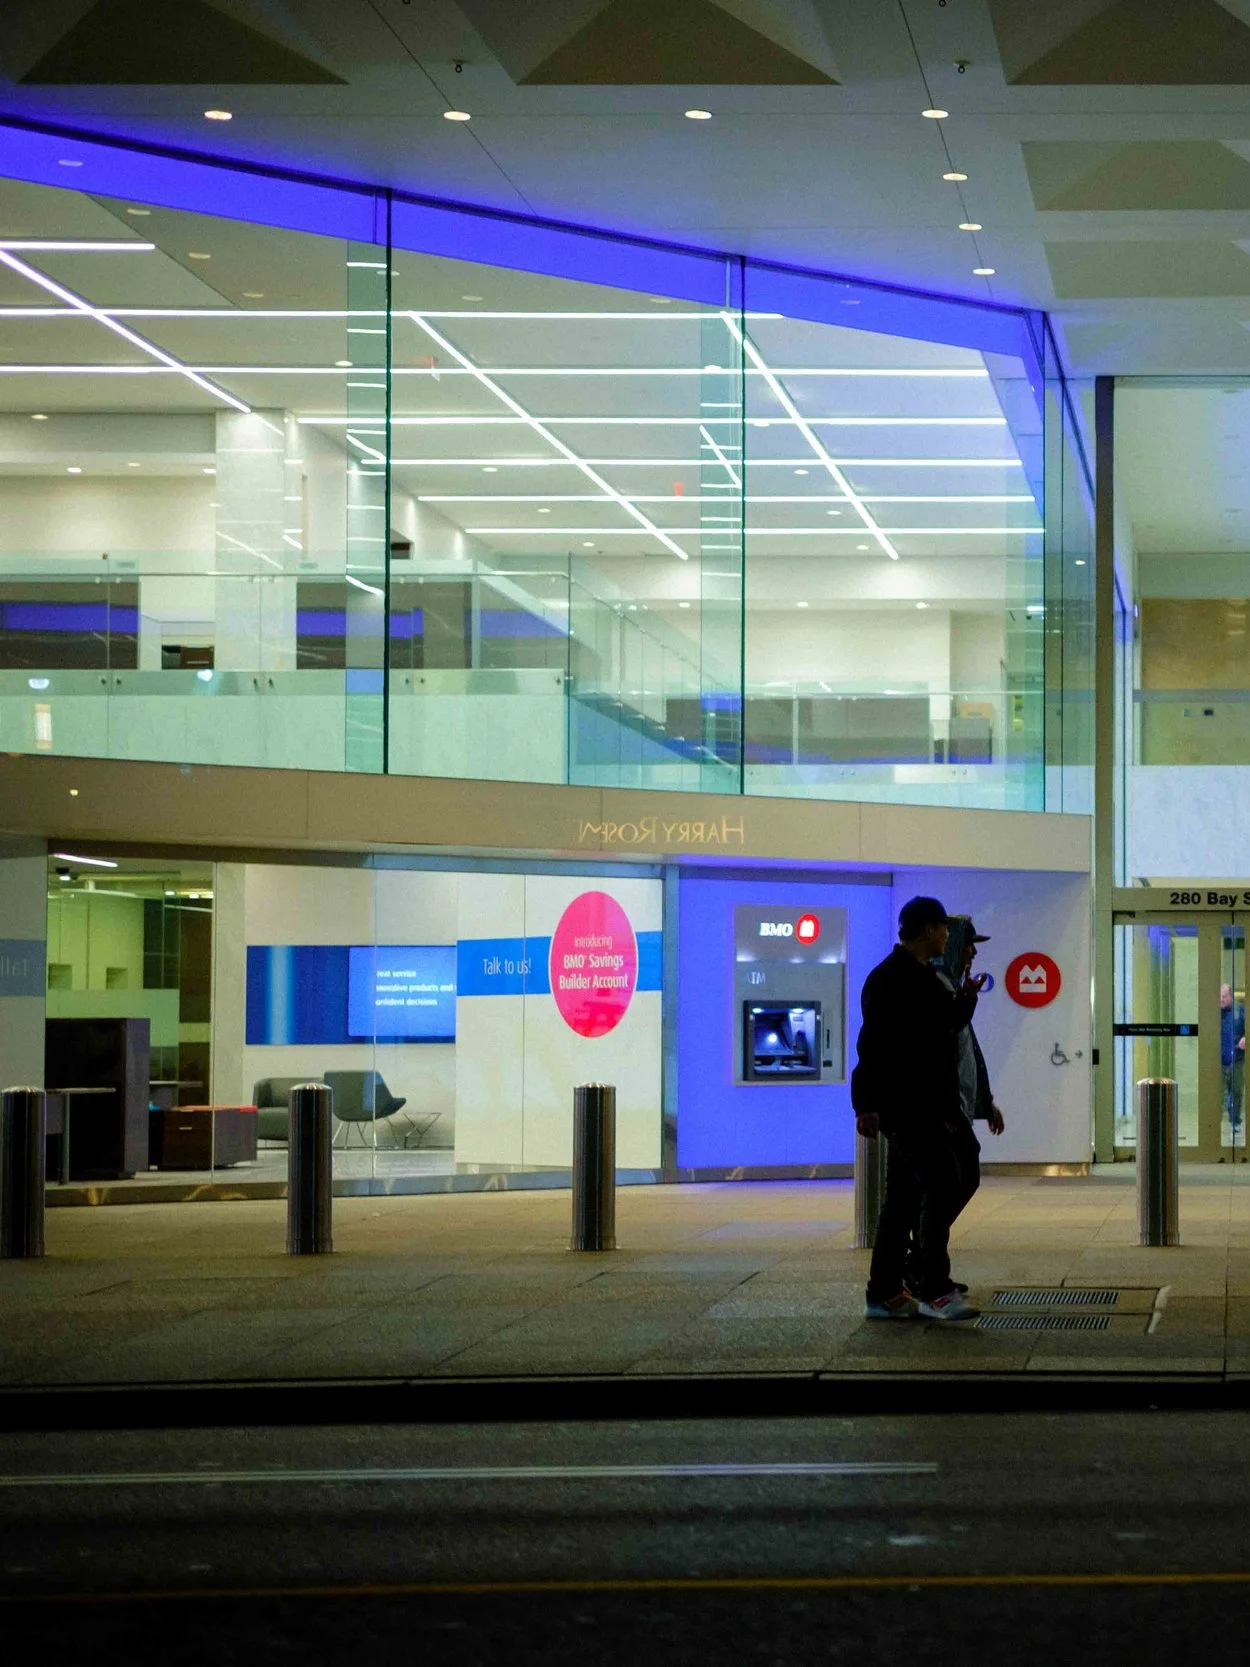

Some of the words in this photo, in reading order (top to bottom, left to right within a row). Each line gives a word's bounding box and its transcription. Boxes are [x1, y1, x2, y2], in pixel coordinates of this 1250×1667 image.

[1170, 892, 1202, 905] 280
[1207, 892, 1238, 908] Bay
[759, 922, 794, 937] BMO
[574, 935, 613, 950] Introducing
[483, 957, 501, 975] Talk
[504, 959, 514, 975] to
[517, 957, 532, 974] us!
[588, 952, 624, 970] Savings
[559, 974, 590, 990] Builder
[592, 973, 629, 990] Account
